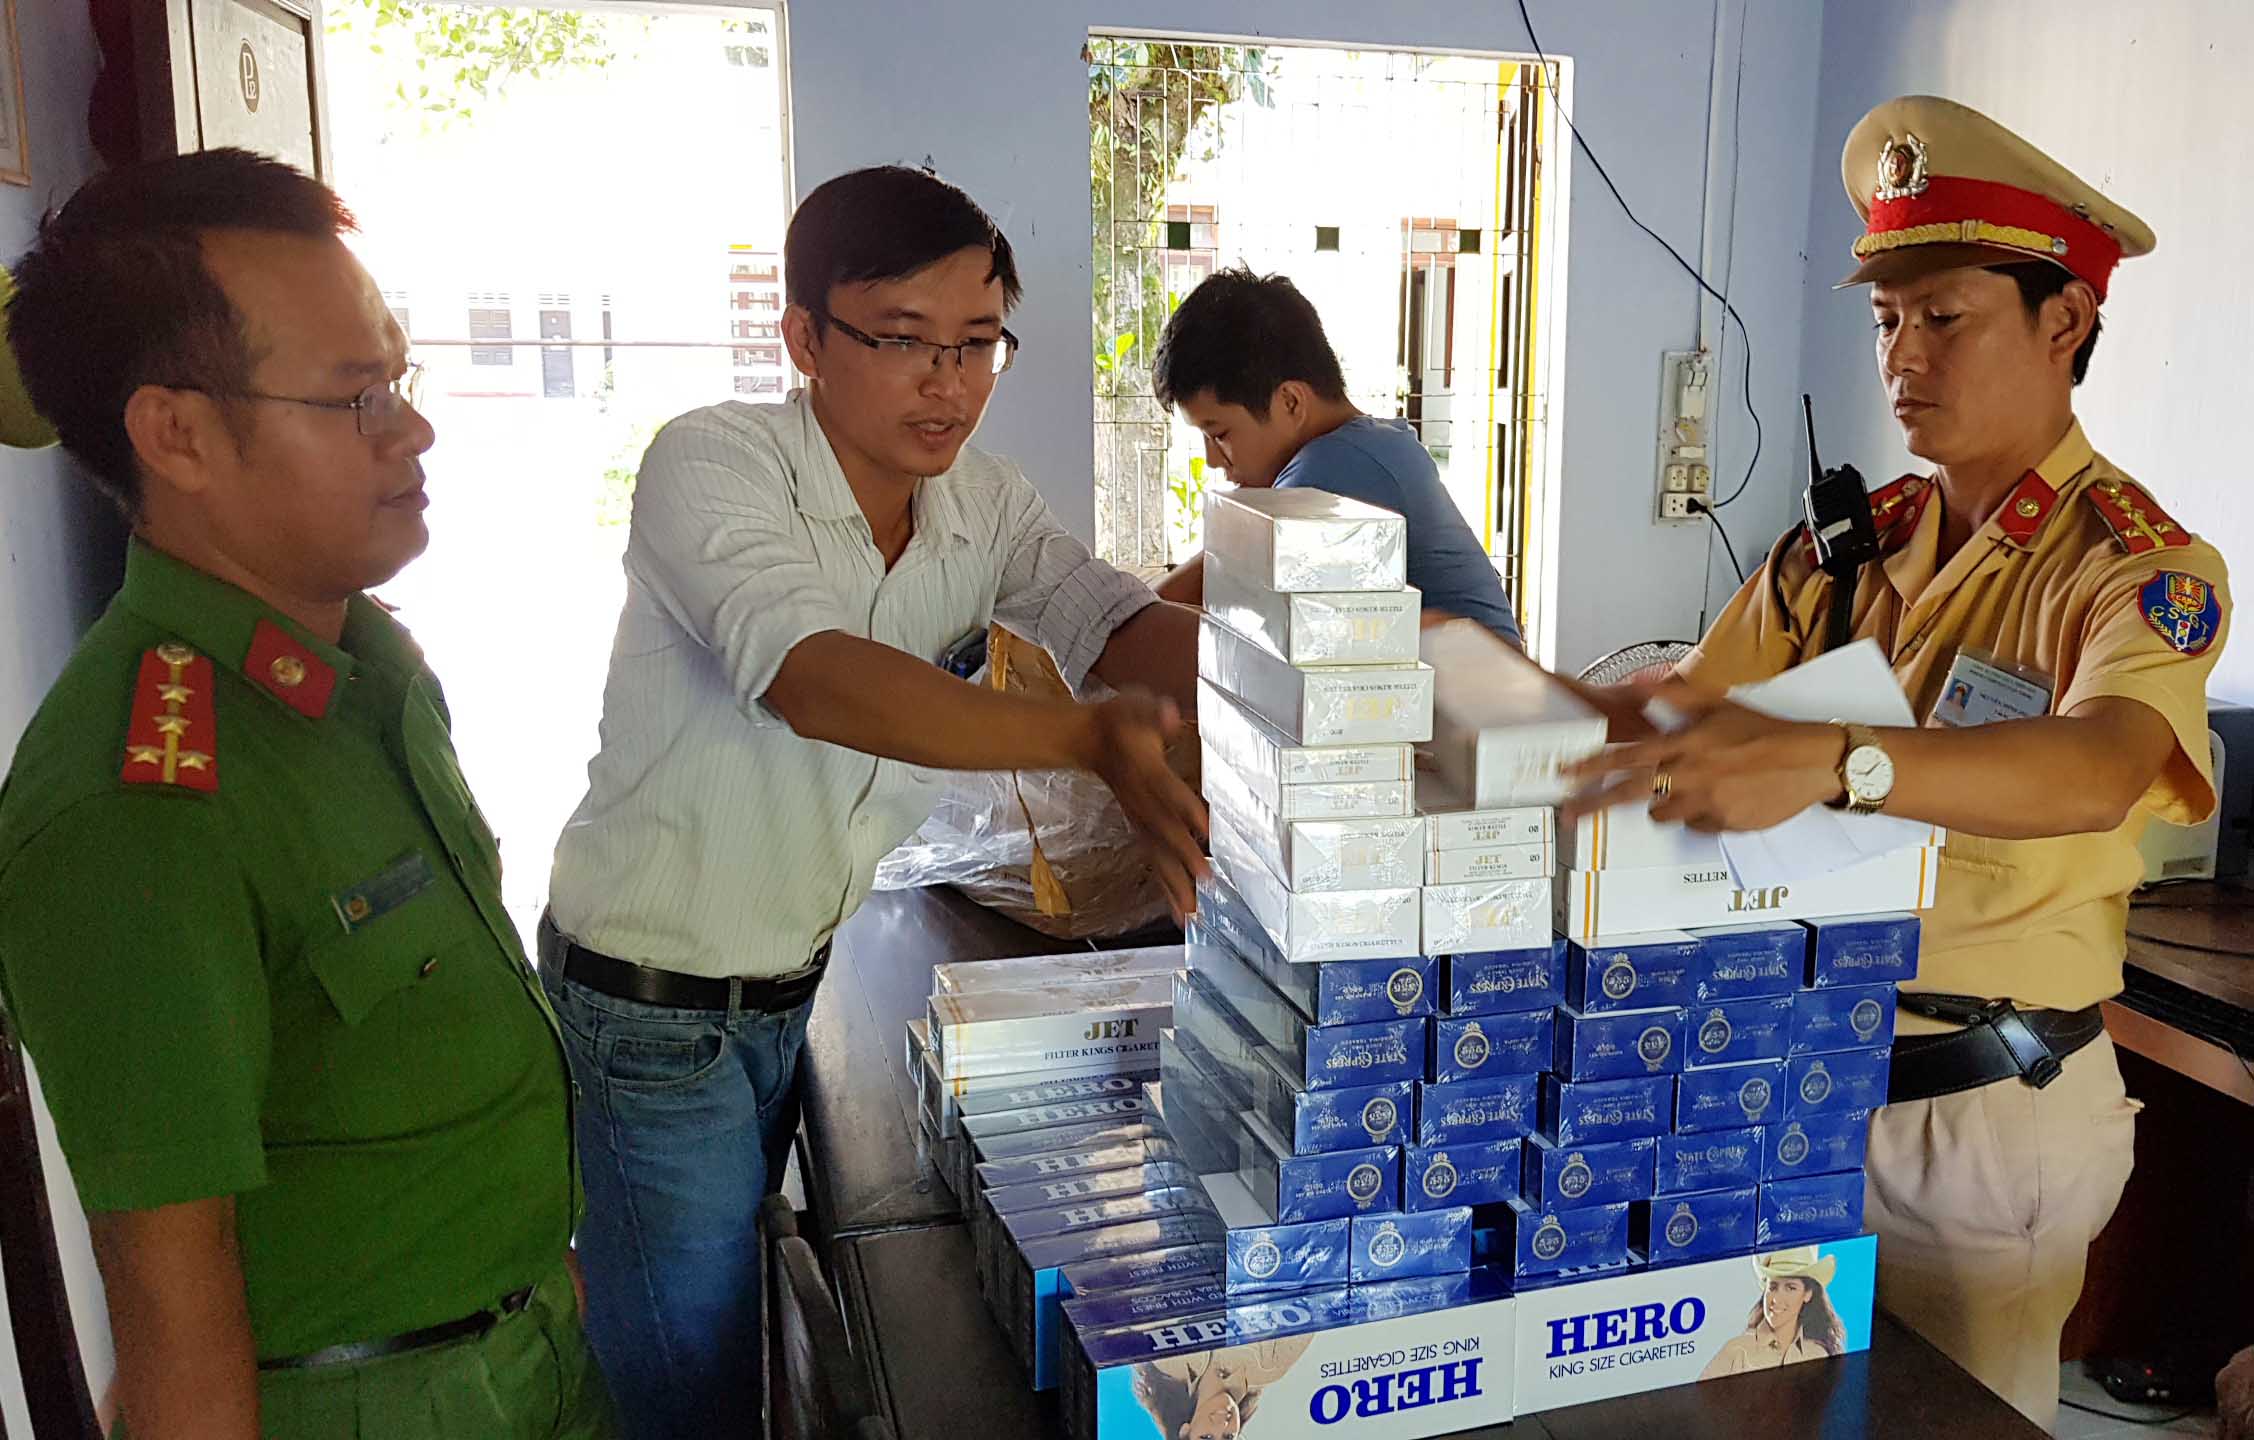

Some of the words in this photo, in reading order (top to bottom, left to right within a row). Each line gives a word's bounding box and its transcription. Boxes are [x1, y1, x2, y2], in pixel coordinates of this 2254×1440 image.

[1683, 871, 1728, 884] RETTES
[1727, 886, 1789, 912] JET
[1517, 971, 1549, 989] STATE
[1083, 1017, 1140, 1041] JET
[1044, 1047, 1079, 1060] FILTER
[1081, 1045, 1114, 1058] KINGS
[1374, 1047, 1407, 1065] STATE
[1008, 1077, 1134, 1103] HERO
[1016, 1098, 1143, 1126] HERO
[1546, 1296, 1706, 1359] HERO
[1410, 1344, 1438, 1362] SIZE
[1443, 1336, 1480, 1356] KING
[1320, 1350, 1406, 1379] CIGARETTES
[1549, 1360, 1584, 1379] KING
[1589, 1355, 1616, 1372] SIZE
[1619, 1340, 1695, 1366] CIGARETTES
[1309, 1357, 1483, 1425] HERO
